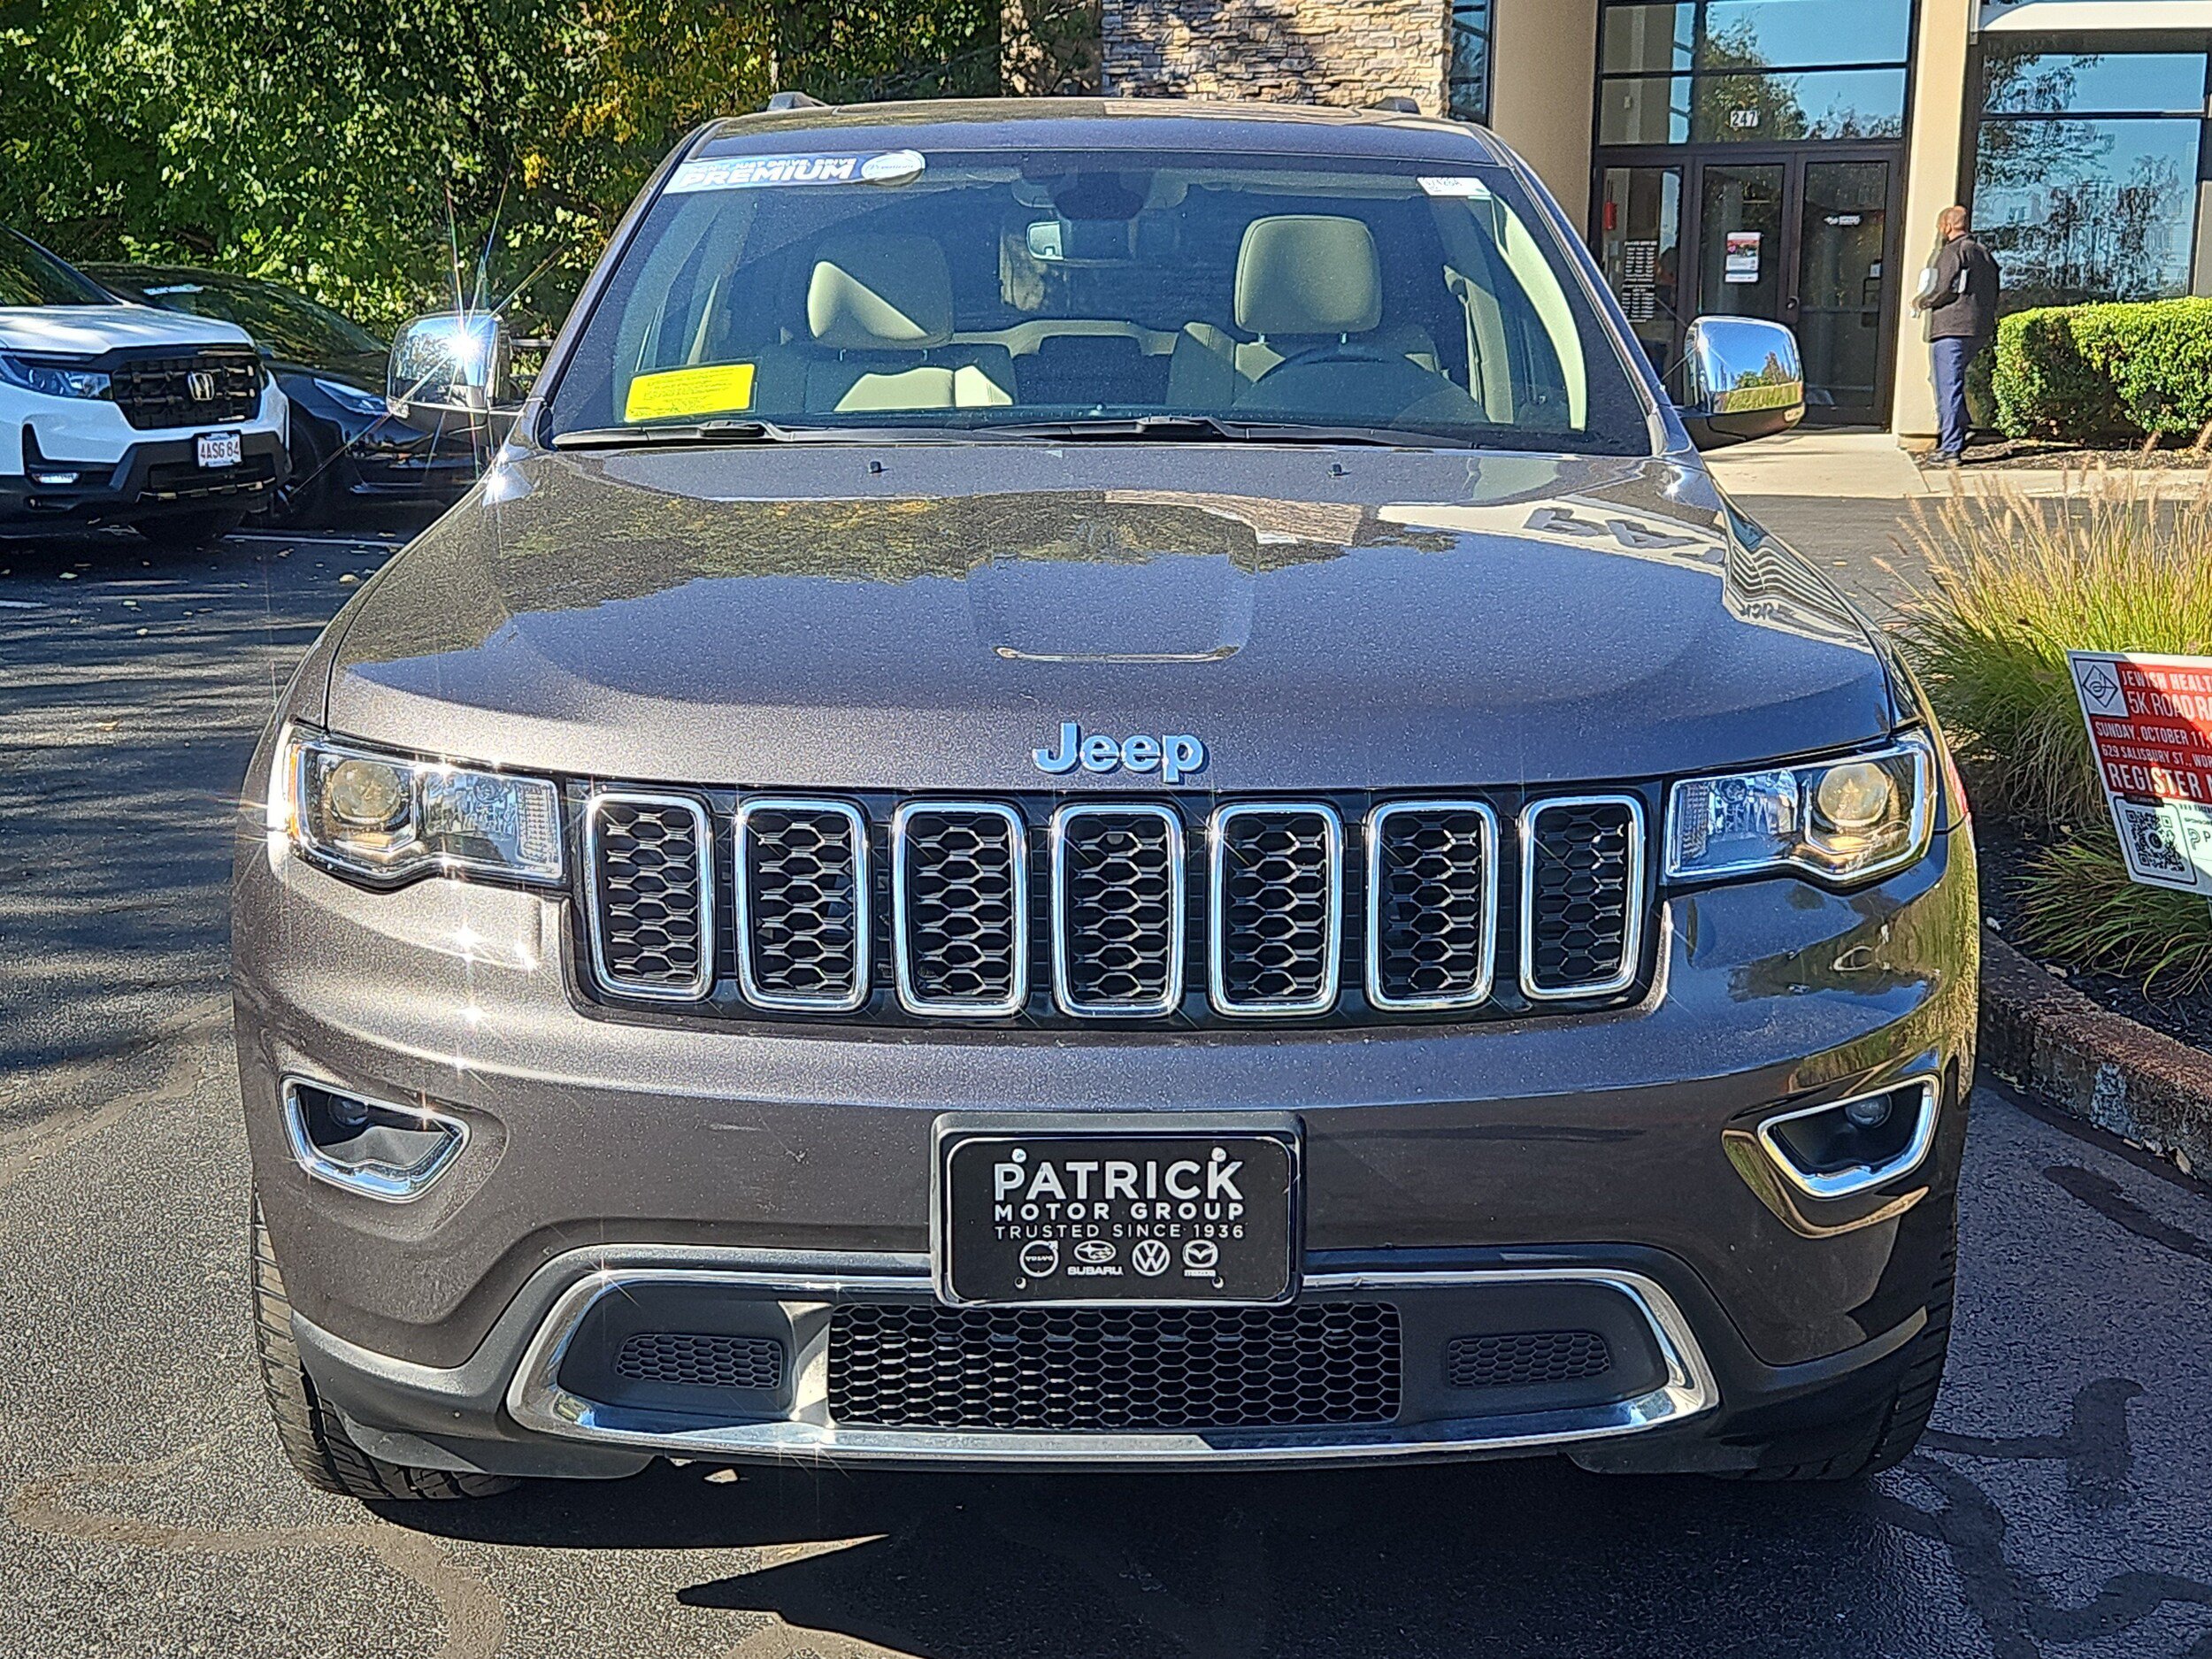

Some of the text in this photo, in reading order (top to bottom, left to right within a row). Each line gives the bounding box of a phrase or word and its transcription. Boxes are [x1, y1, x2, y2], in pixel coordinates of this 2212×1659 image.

[1732, 111, 1755, 127] 247
[680, 164, 856, 188] PREMIUM
[2122, 671, 2212, 693] JEWISH HEALT
[2126, 690, 2151, 716] 5K
[2150, 693, 2195, 722] ROAD
[2095, 721, 2141, 741] SUNDAY,
[2140, 726, 2190, 746] OCTOBER
[1033, 722, 1205, 783] Jeep
[2101, 744, 2120, 758] 629
[2120, 747, 2170, 764] SALISBURY
[2107, 763, 2203, 799] REGISTER
[995, 1160, 1244, 1202] PATRICK
[995, 1202, 1244, 1222] MOTOR GROUP
[995, 1224, 1244, 1240] TRUSTED SINCE 1936
[1067, 1265, 1124, 1276] SUBARU
